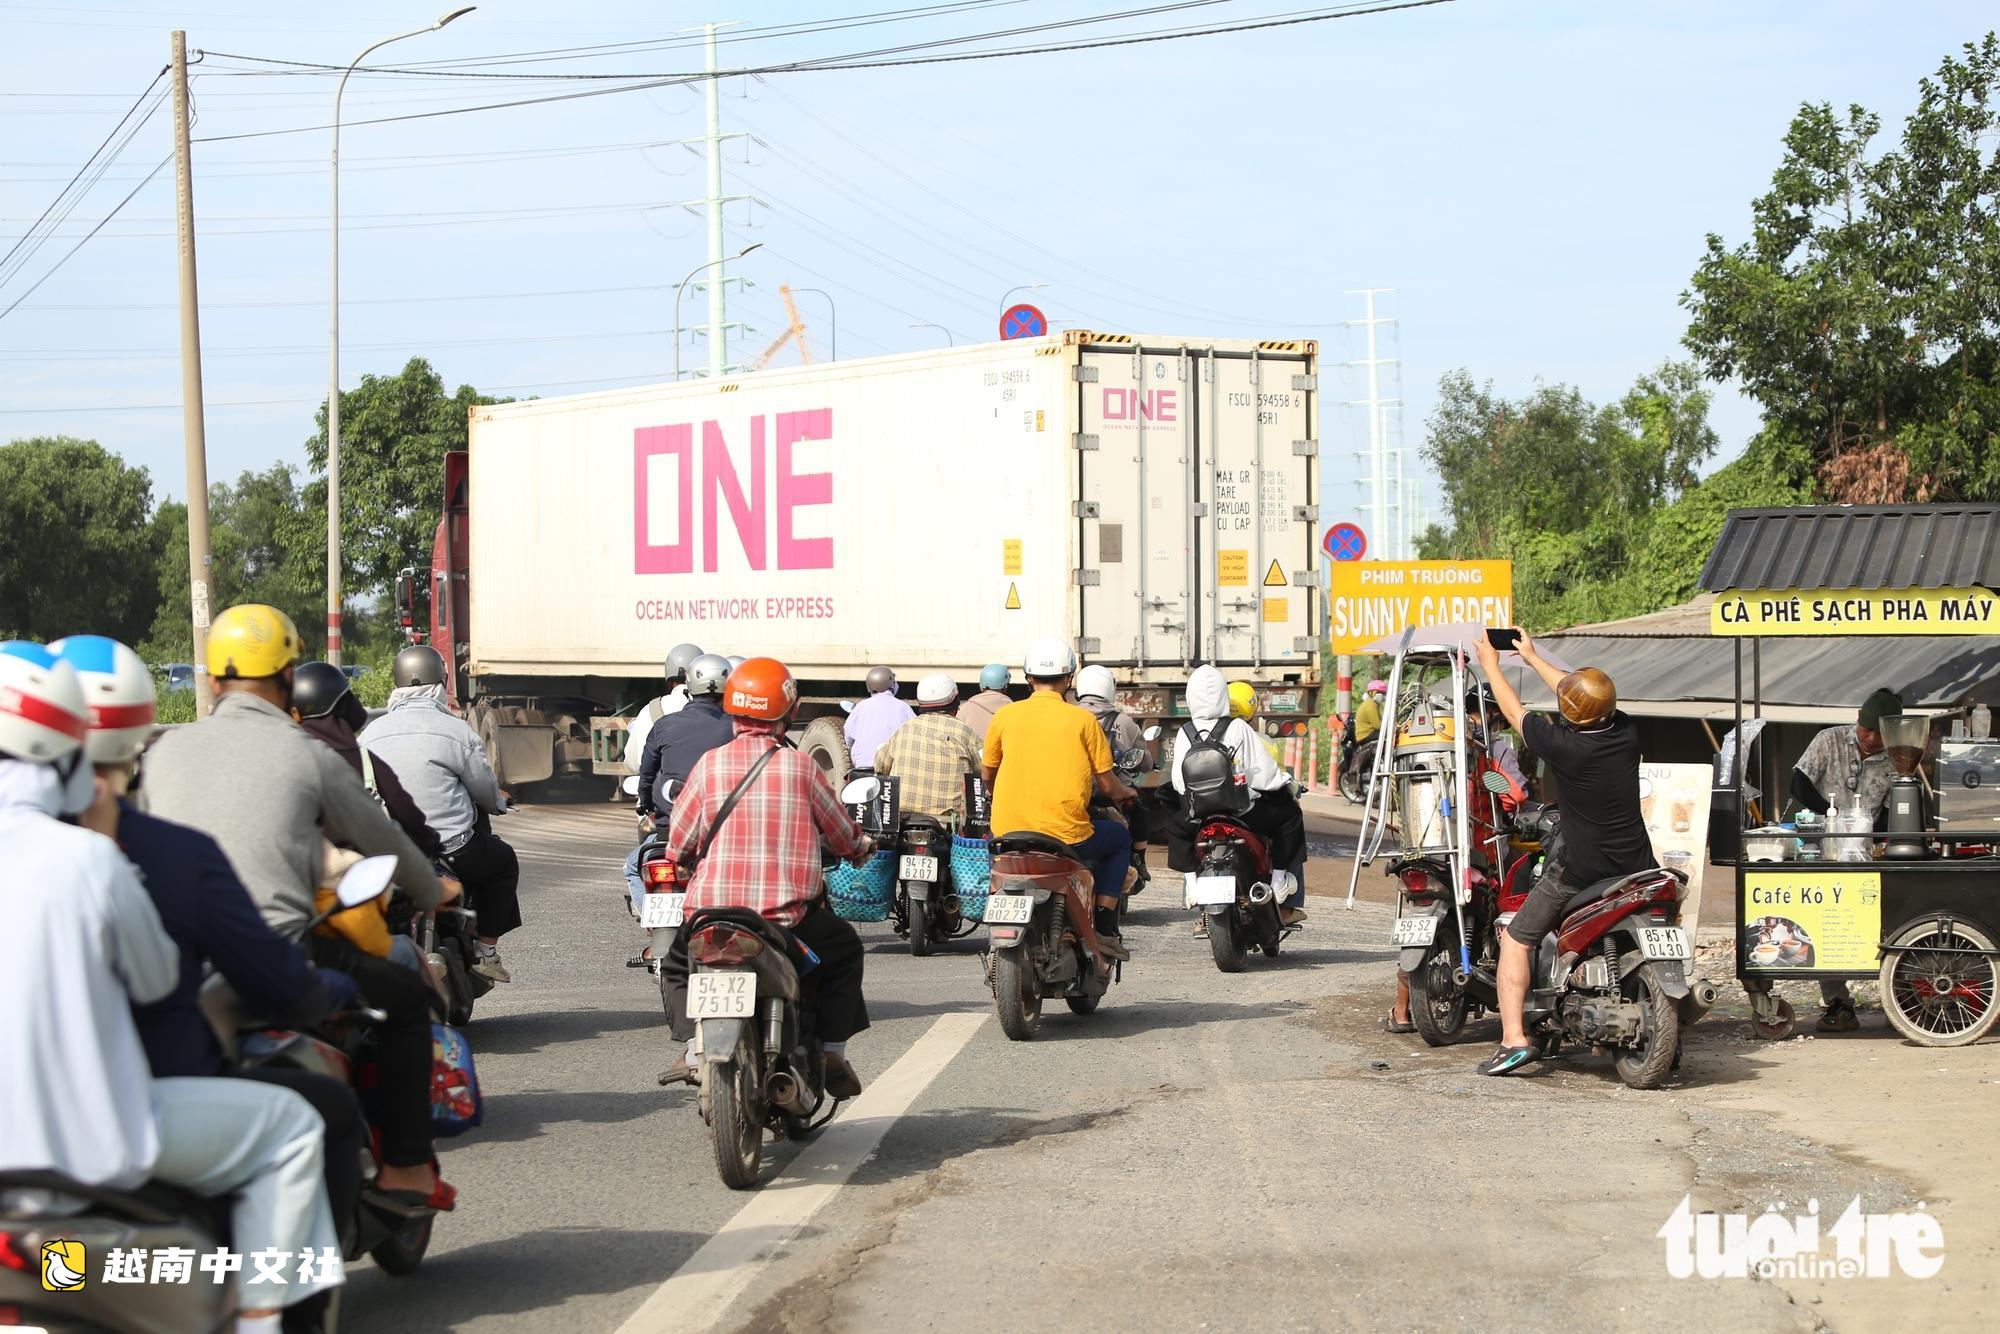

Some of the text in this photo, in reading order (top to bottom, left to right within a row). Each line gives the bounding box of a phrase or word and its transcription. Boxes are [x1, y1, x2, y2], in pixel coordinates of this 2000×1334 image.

[1103, 387, 1177, 422] ONE
[1228, 392, 1300, 409] FSCU 594558 6
[1257, 411, 1279, 425] 45R1
[1216, 470, 1251, 484] MAX GR
[634, 407, 834, 575] ONE
[1216, 486, 1236, 499] TARE
[1216, 501, 1250, 515] PAYLOAD
[1217, 517, 1251, 530] CU CAP
[1360, 570, 1404, 585] PHIM
[636, 597, 834, 620] OCEAN NETWORK EXPRESS
[1720, 594, 1993, 626] CÀ PHÊ SẠCH PHA MÁY
[1334, 596, 1510, 638] SUNNY GARDEN
[745, 701, 768, 710] Food
[1639, 768, 1671, 779] ENU
[883, 803, 891, 825] FRESH
[906, 857, 932, 868] 94-F2
[905, 868, 932, 879] 6207
[1752, 885, 1793, 904] Café
[650, 896, 683, 910] 52-X2
[648, 910, 682, 924] 4770
[1400, 920, 1431, 932] 59-S2
[1649, 943, 1684, 957] 0430
[699, 977, 746, 994] 54-X2
[698, 997, 745, 1013] 7515
